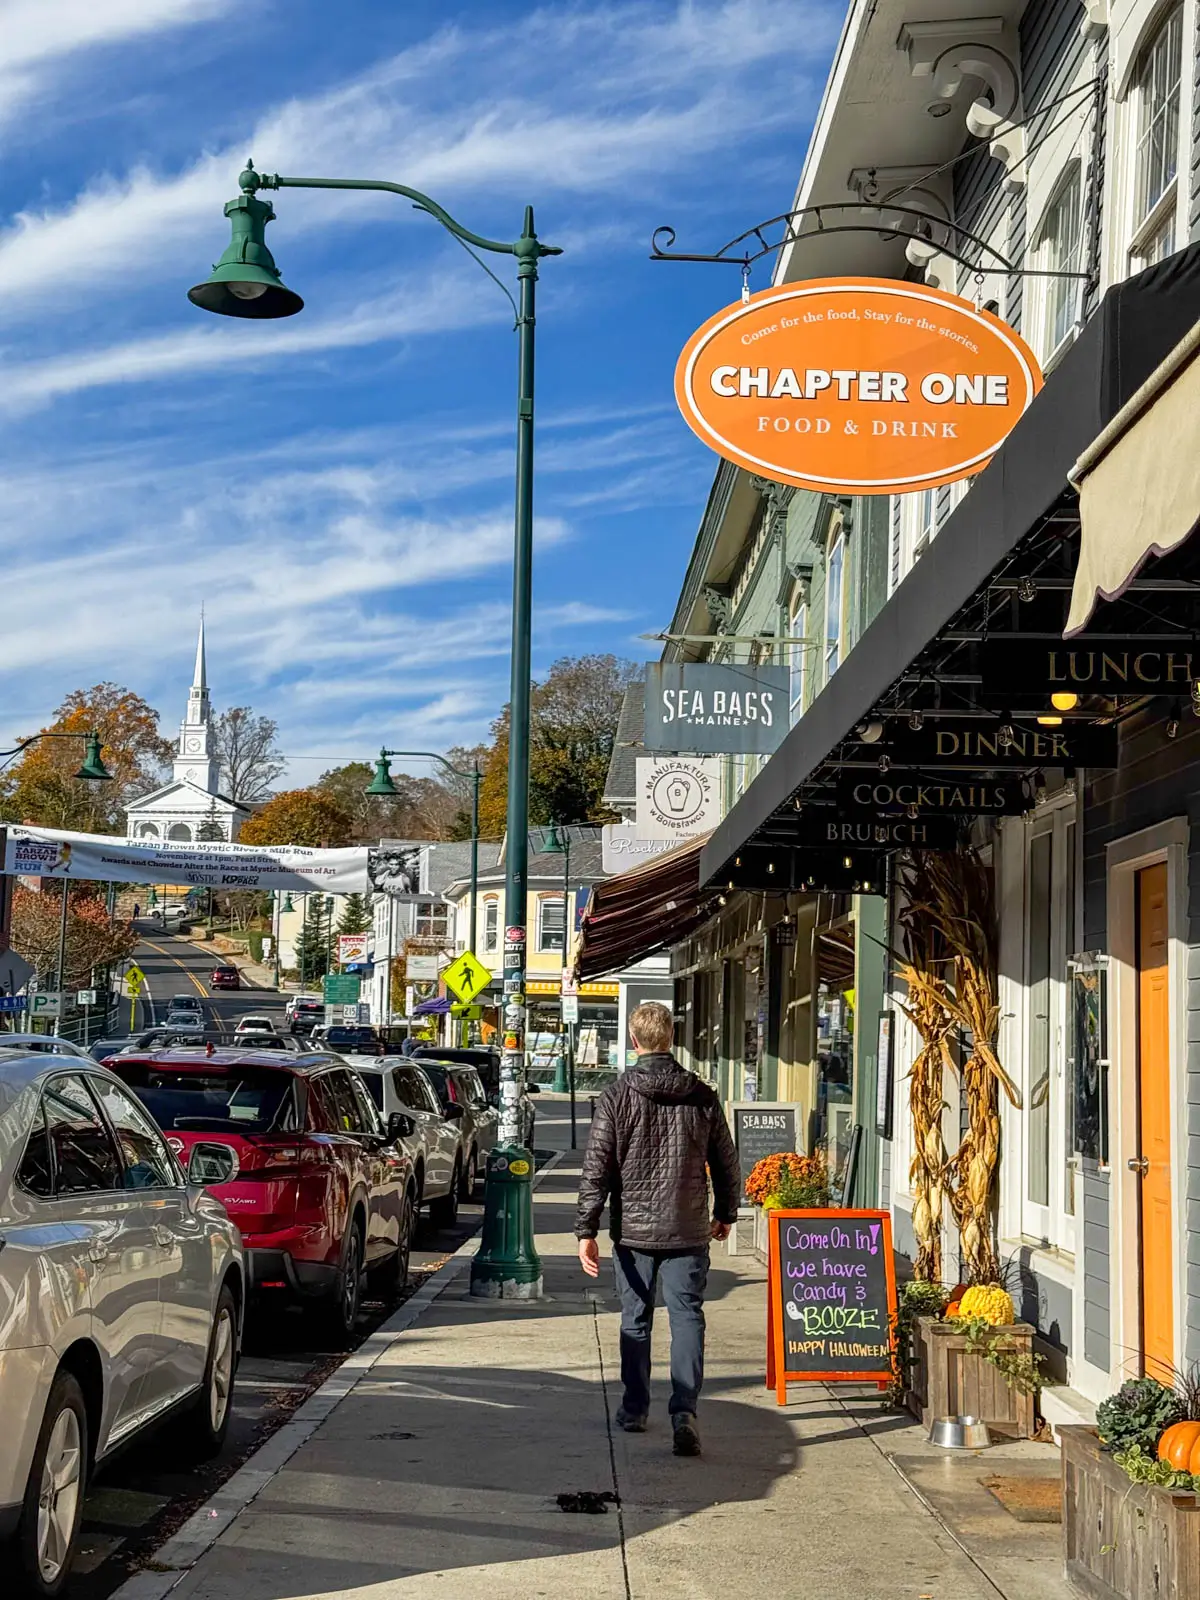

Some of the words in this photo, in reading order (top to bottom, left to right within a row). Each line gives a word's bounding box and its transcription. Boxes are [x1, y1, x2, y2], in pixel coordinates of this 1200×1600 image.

[741, 324, 778, 345] Come
[780, 317, 800, 329] for
[803, 311, 824, 324] the
[827, 309, 860, 321] food,
[864, 309, 892, 325] Stay
[895, 312, 915, 326] for
[916, 315, 937, 332] the
[939, 327, 979, 354] stories.
[710, 365, 908, 402] CHAPTER
[920, 374, 1009, 406] ONE
[757, 416, 831, 435] FOOD
[843, 419, 860, 436] &
[872, 420, 959, 439] DRINK
[1047, 651, 1193, 683] LUNCH
[662, 689, 704, 724] SEA
[713, 690, 773, 727] BAGS
[695, 716, 740, 727] MAINE
[936, 731, 1072, 758] DINNER
[646, 762, 711, 792] MANUFAKTURA
[674, 788, 682, 797] B
[853, 784, 1006, 808] COCKTAILS
[649, 808, 658, 817] w
[16, 847, 58, 855] TARZAN
[126, 840, 160, 850] Tarzan
[163, 843, 195, 851] Brown
[197, 844, 232, 852] Mystic
[293, 848, 314, 856] Run
[609, 838, 676, 854] Rochell
[16, 853, 57, 861] BROWN
[101, 856, 130, 865] Awards
[131, 859, 146, 867] and
[147, 860, 182, 869] Chowder
[249, 865, 277, 874] Mystic
[279, 866, 313, 874] Museum
[323, 867, 337, 875] Art
[155, 852, 198, 861] November
[258, 856, 281, 864] Street
[14, 862, 42, 871] RUN
[34, 996, 48, 1012] P
[345, 1008, 356, 1016] 215
[743, 1115, 760, 1129] SEA
[762, 1115, 786, 1129] BAGS
[787, 1225, 829, 1250] Come
[831, 1226, 851, 1249] On
[854, 1224, 880, 1255] In!
[821, 1258, 868, 1278] have
[793, 1281, 847, 1309] Candy
[803, 1305, 880, 1331] BOOZE
[788, 1339, 826, 1356] HAPPY
